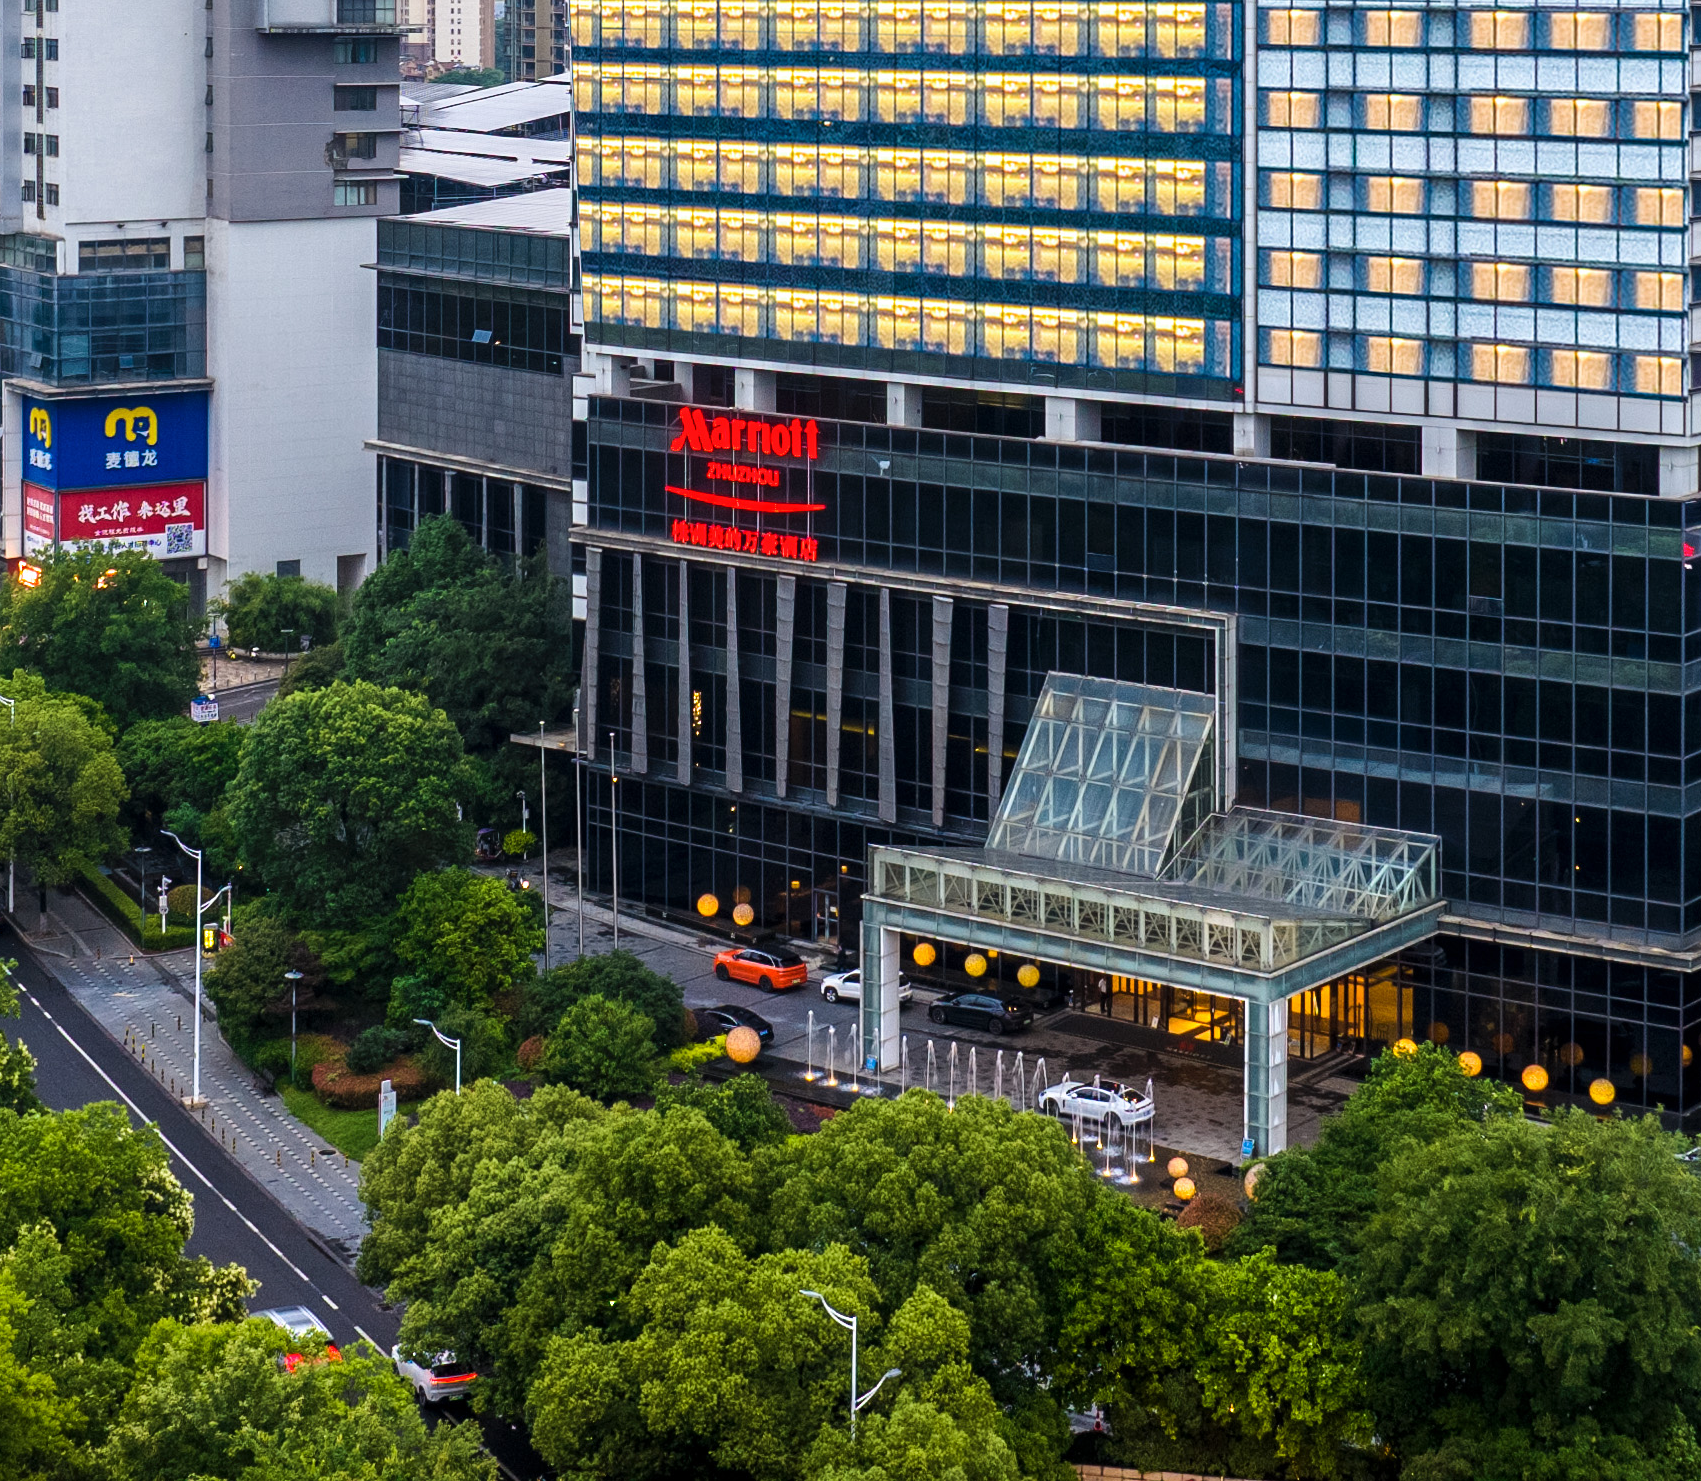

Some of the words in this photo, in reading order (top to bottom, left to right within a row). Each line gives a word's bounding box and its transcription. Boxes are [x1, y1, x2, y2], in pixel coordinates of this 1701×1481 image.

[671, 406, 818, 459] Marriott
[105, 449, 158, 470] 麦德龙
[707, 462, 780, 487] ZHUZHOU
[78, 500, 131, 524] 找工作
